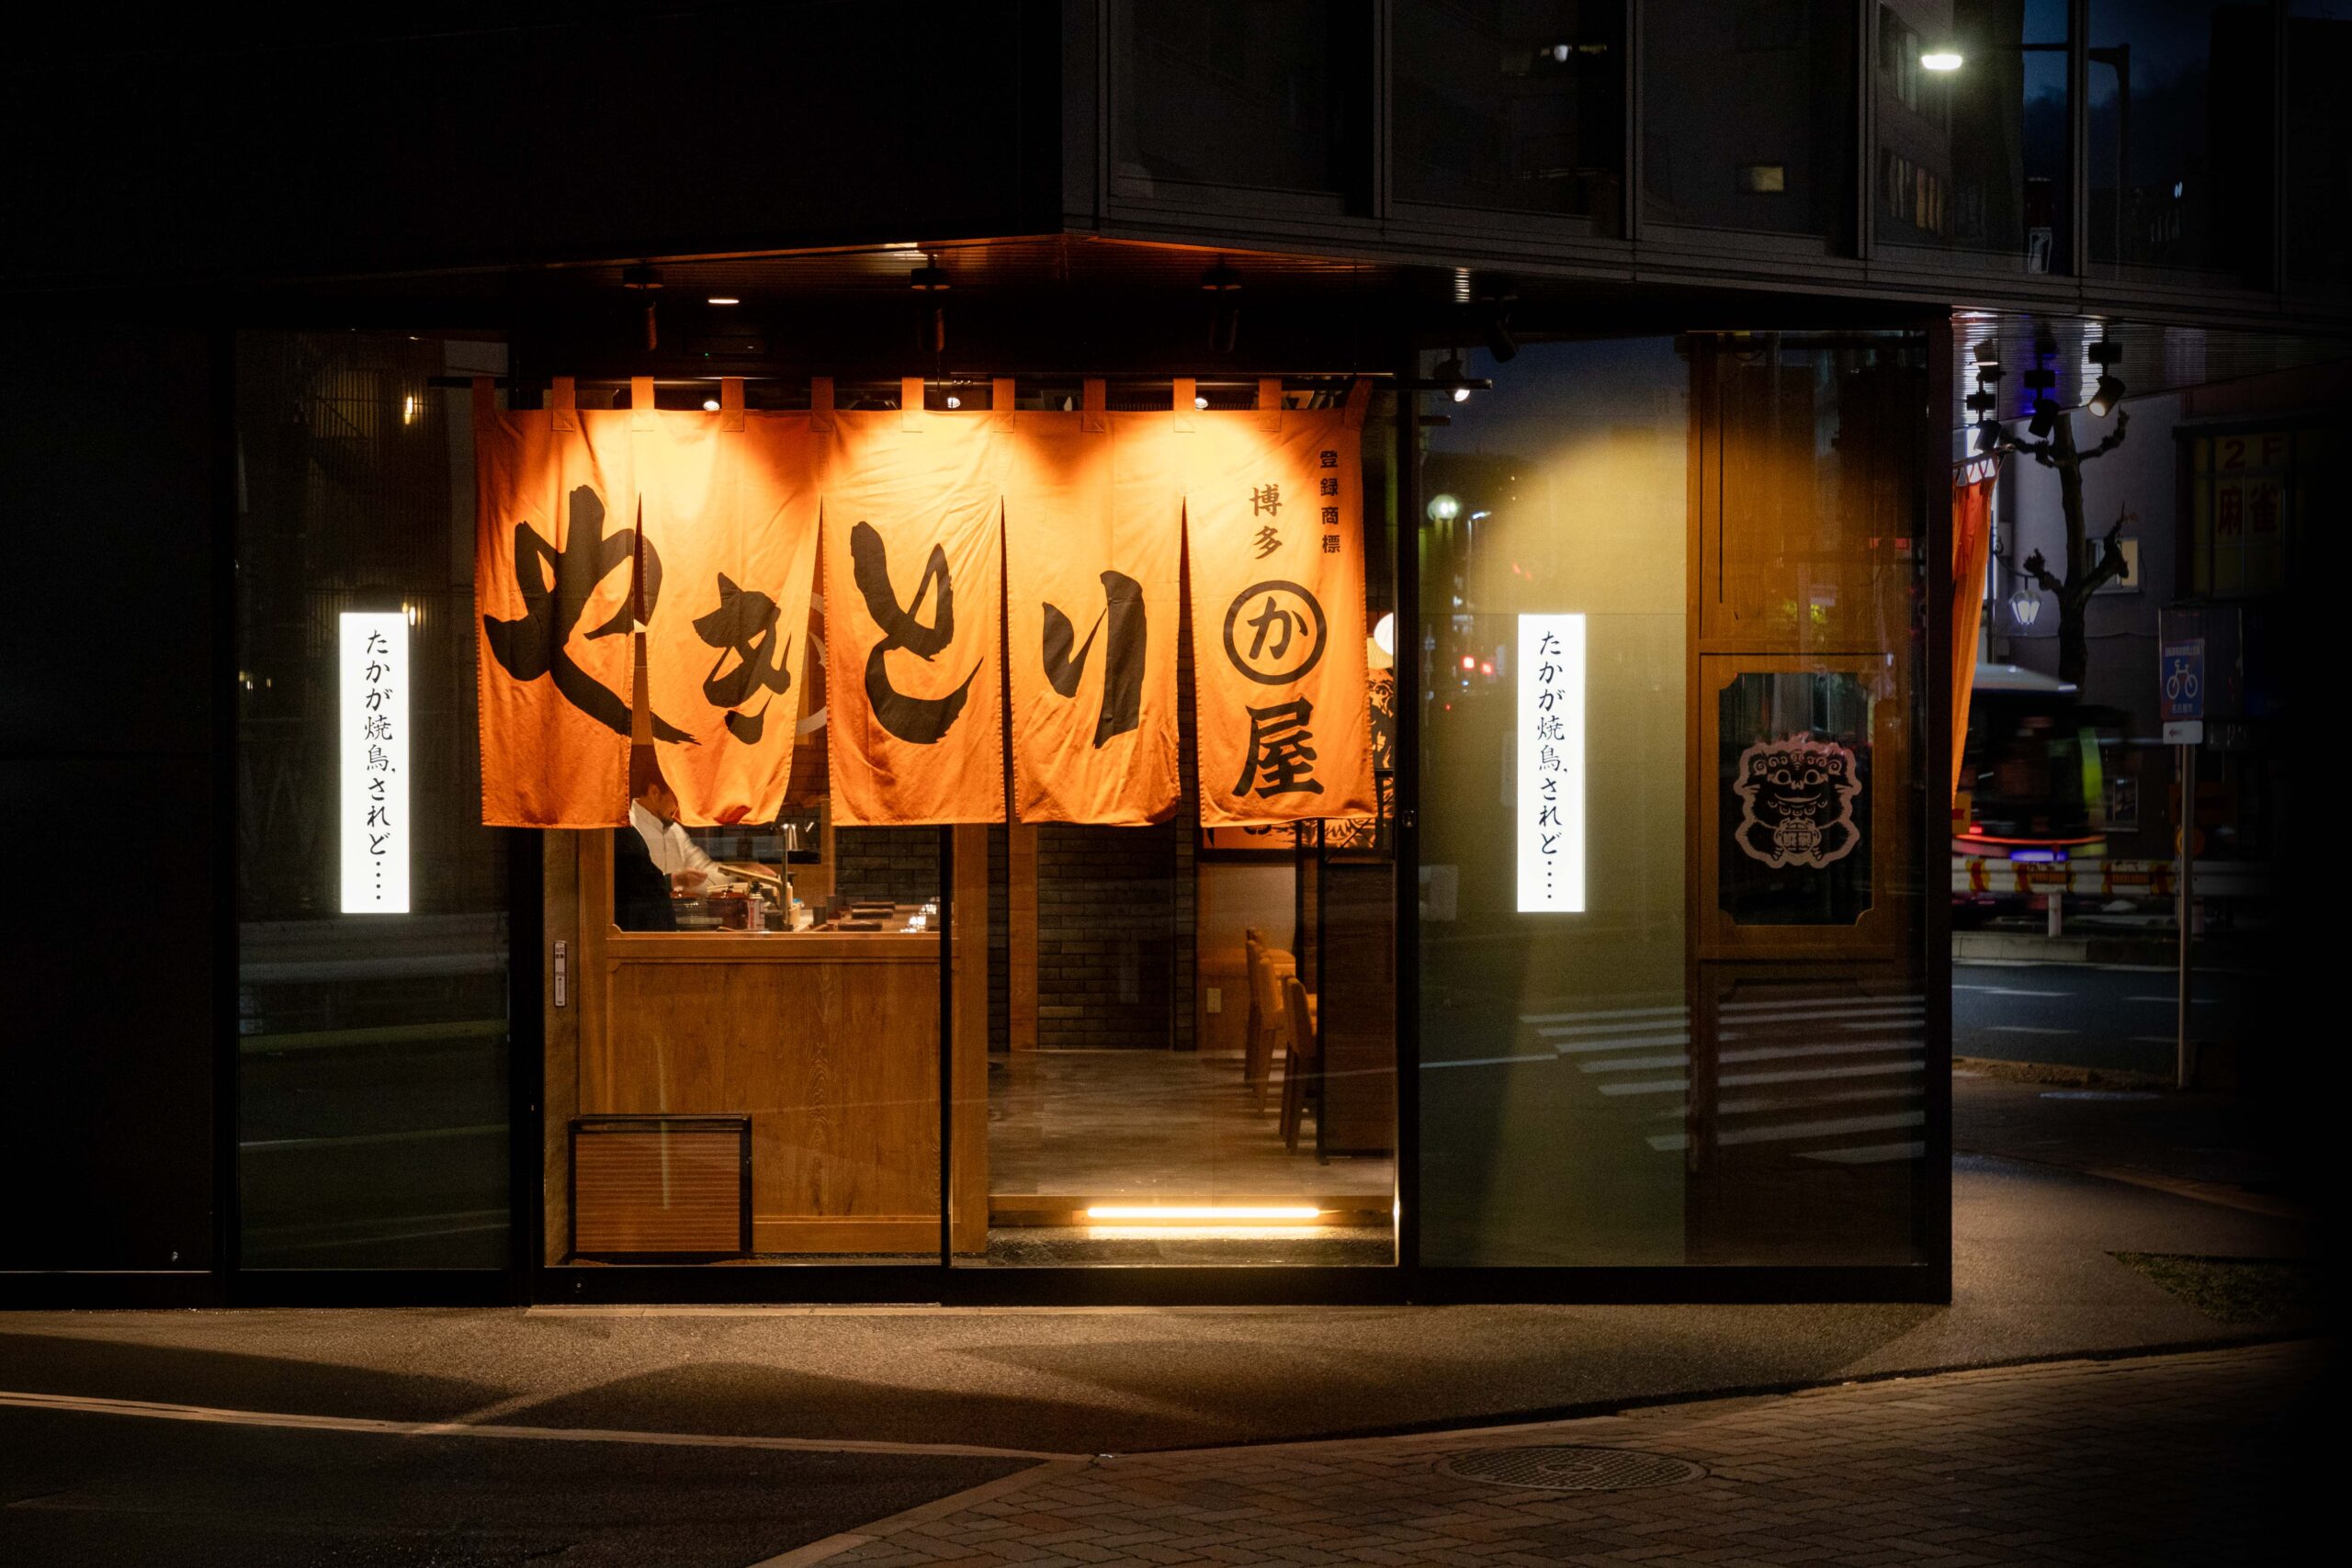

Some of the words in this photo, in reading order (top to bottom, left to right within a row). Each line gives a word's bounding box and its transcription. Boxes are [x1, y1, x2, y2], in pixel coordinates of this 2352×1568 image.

[1250, 483, 1283, 559] 博多
[1320, 450, 1340, 553] 登録商標
[2219, 482, 2278, 536] 麻雀
